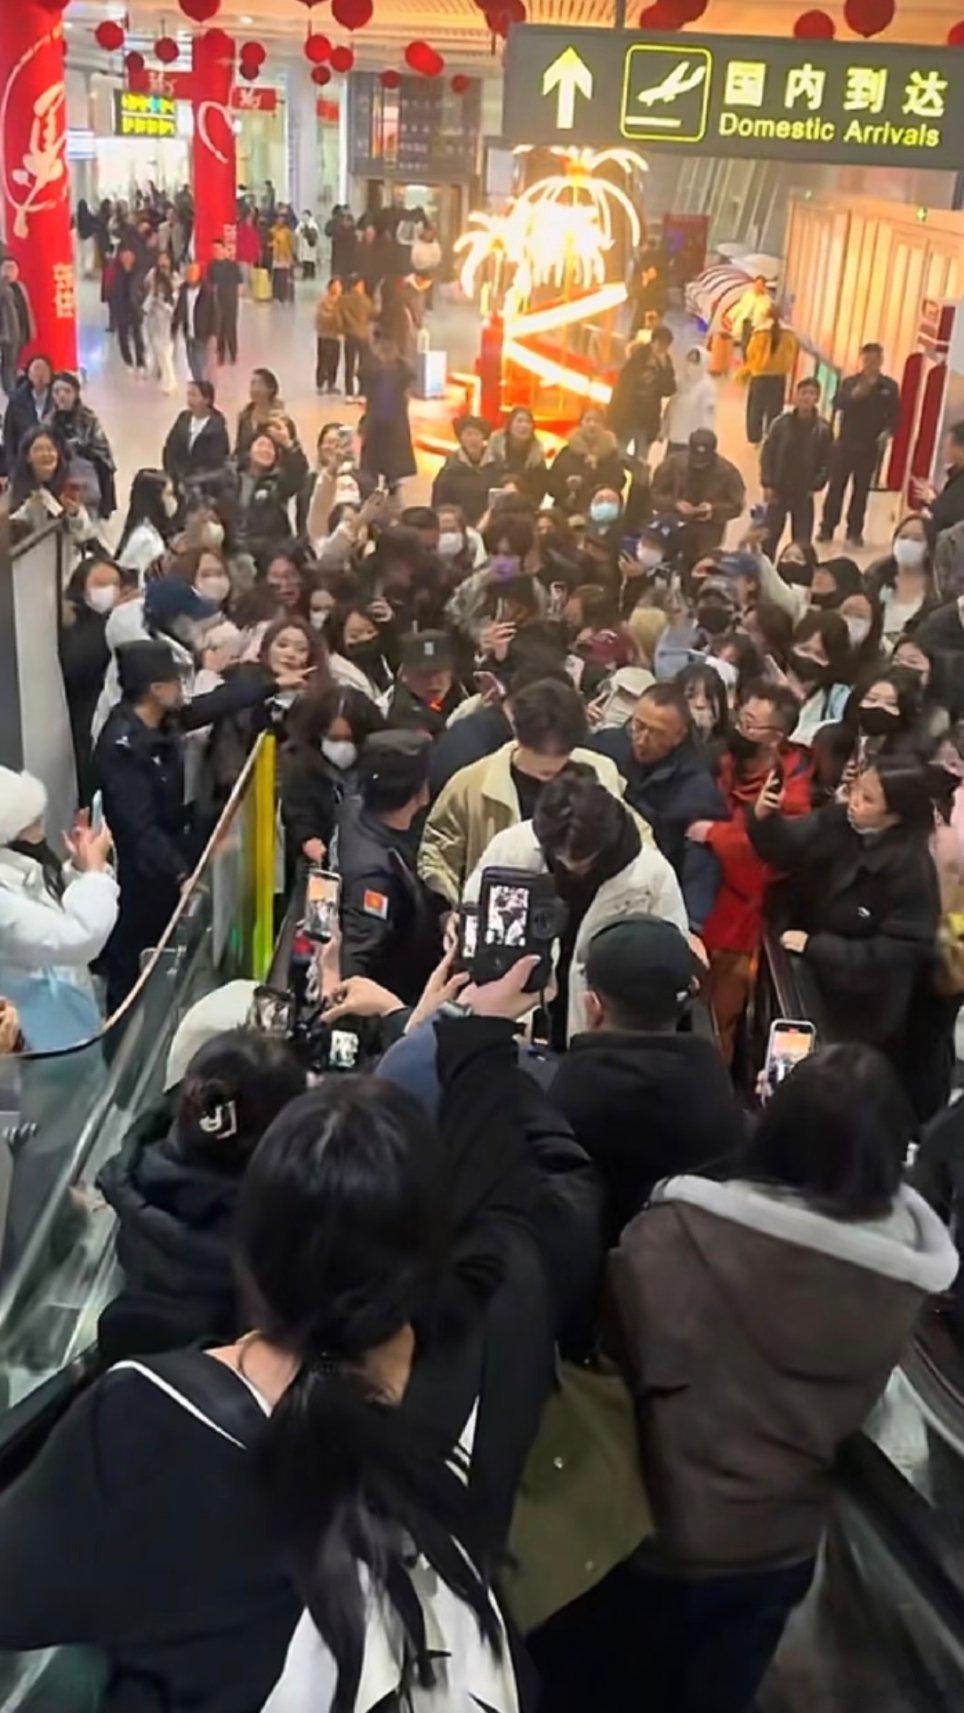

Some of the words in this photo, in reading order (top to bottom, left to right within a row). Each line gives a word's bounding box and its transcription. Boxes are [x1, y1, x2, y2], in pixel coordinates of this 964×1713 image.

[724, 61, 948, 117] 国内到达
[719, 113, 835, 141] Domestic
[843, 120, 940, 147] Arrivals
